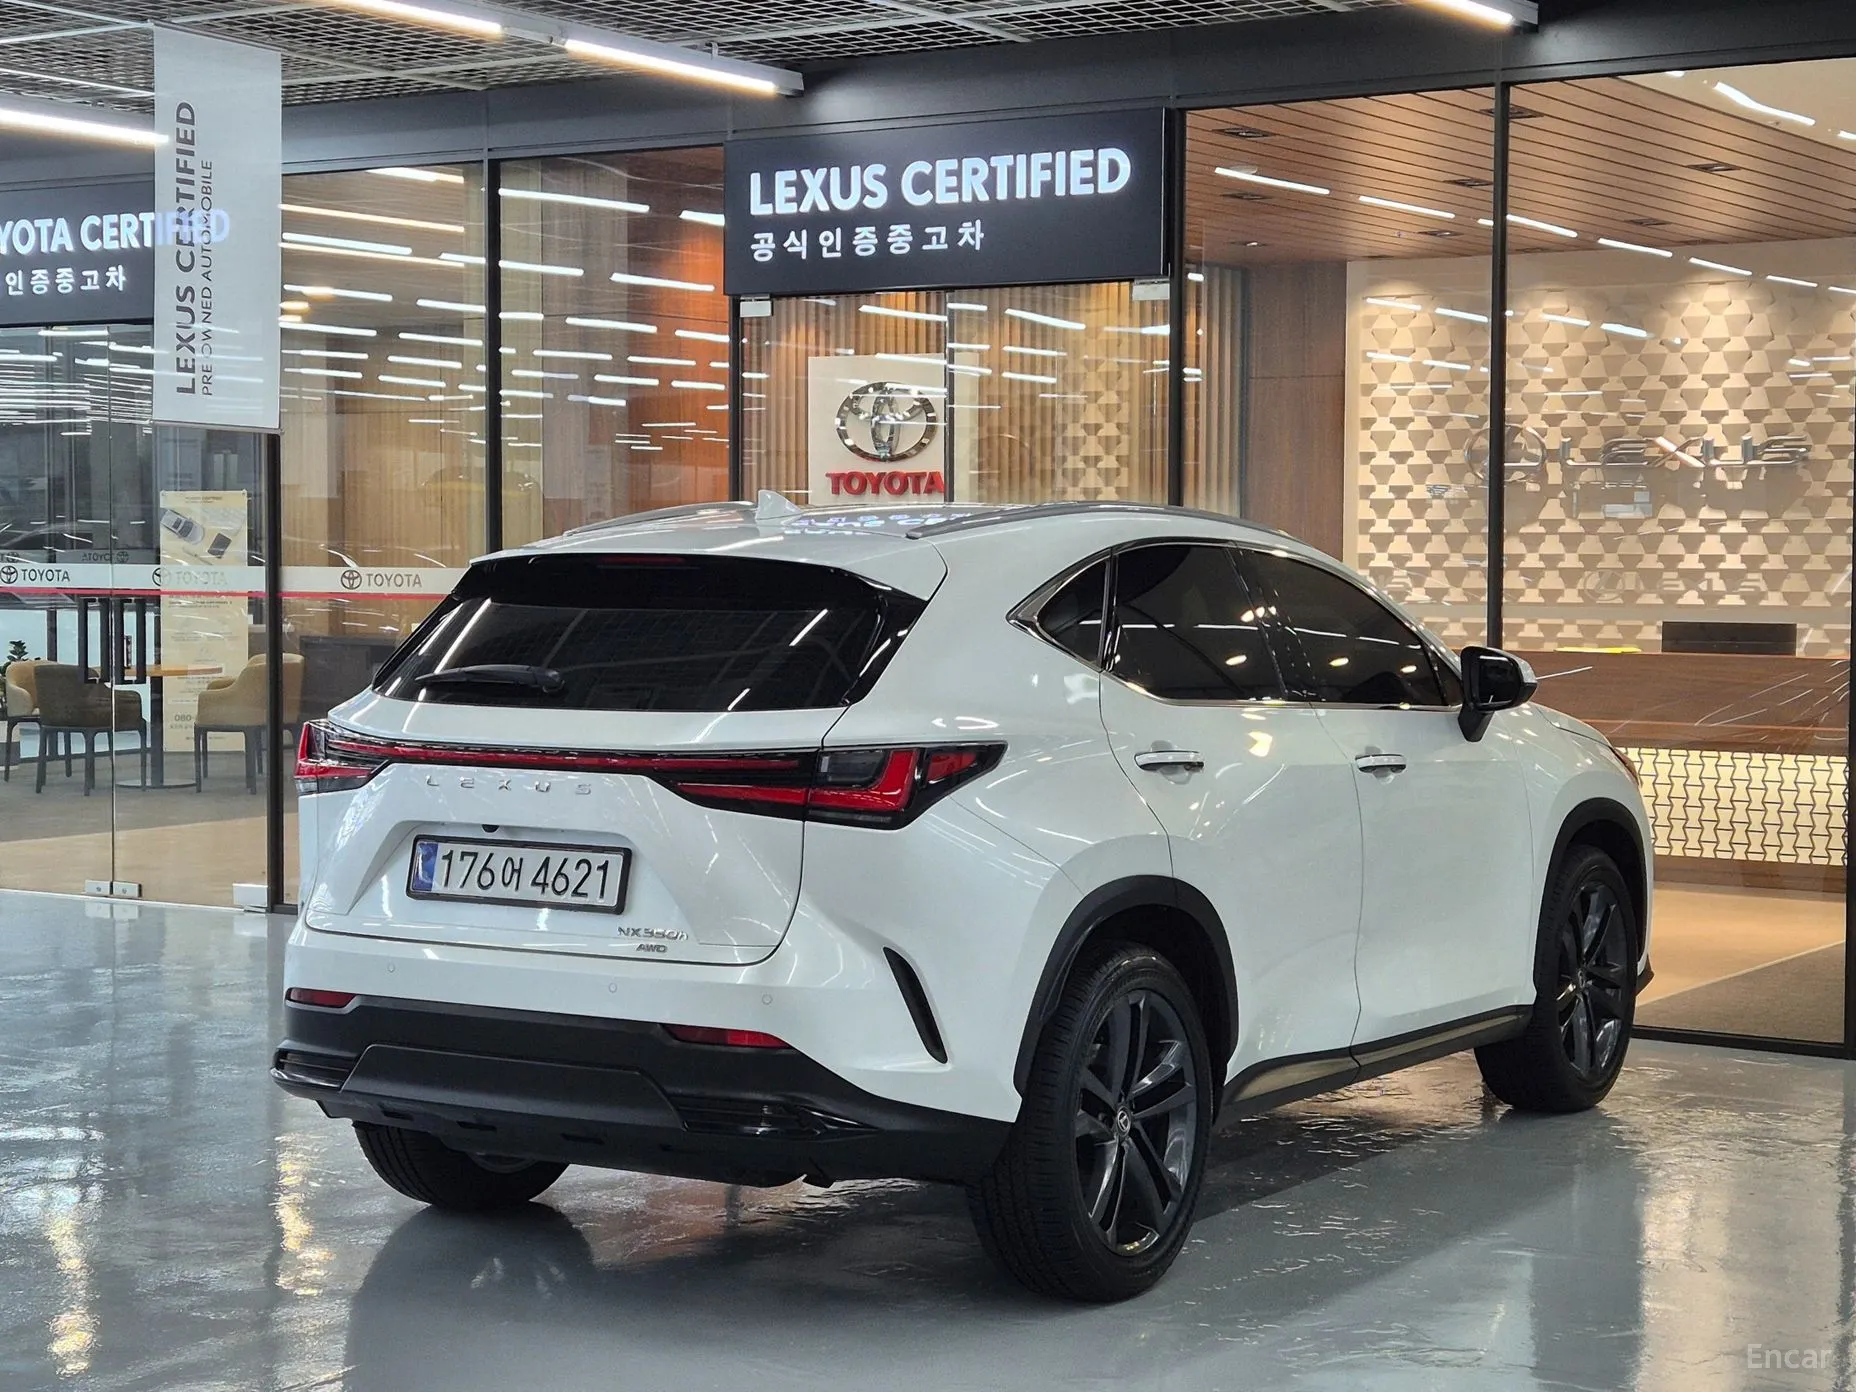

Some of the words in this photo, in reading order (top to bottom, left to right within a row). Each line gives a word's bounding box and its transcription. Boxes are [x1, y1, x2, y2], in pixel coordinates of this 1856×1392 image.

[175, 101, 196, 273] CERTIFIED
[750, 164, 889, 216] LEXUS
[900, 147, 1132, 207] CERTIFIED
[200, 160, 213, 282] AUTOMOBILE
[200, 286, 213, 358] OWNED
[175, 284, 196, 395] LEXUS
[201, 363, 214, 396] PRE
[1560, 434, 1809, 468] LEXUS
[825, 470, 945, 497] TOYOTA
[21, 568, 71, 583] TOYOTA
[175, 570, 228, 586] TOYOTA
[365, 572, 423, 588] TOYOTA
[425, 774, 592, 796] LEXUS
[440, 849, 524, 892] 176어
[530, 856, 610, 900] 4621
[635, 943, 668, 953] AWD
